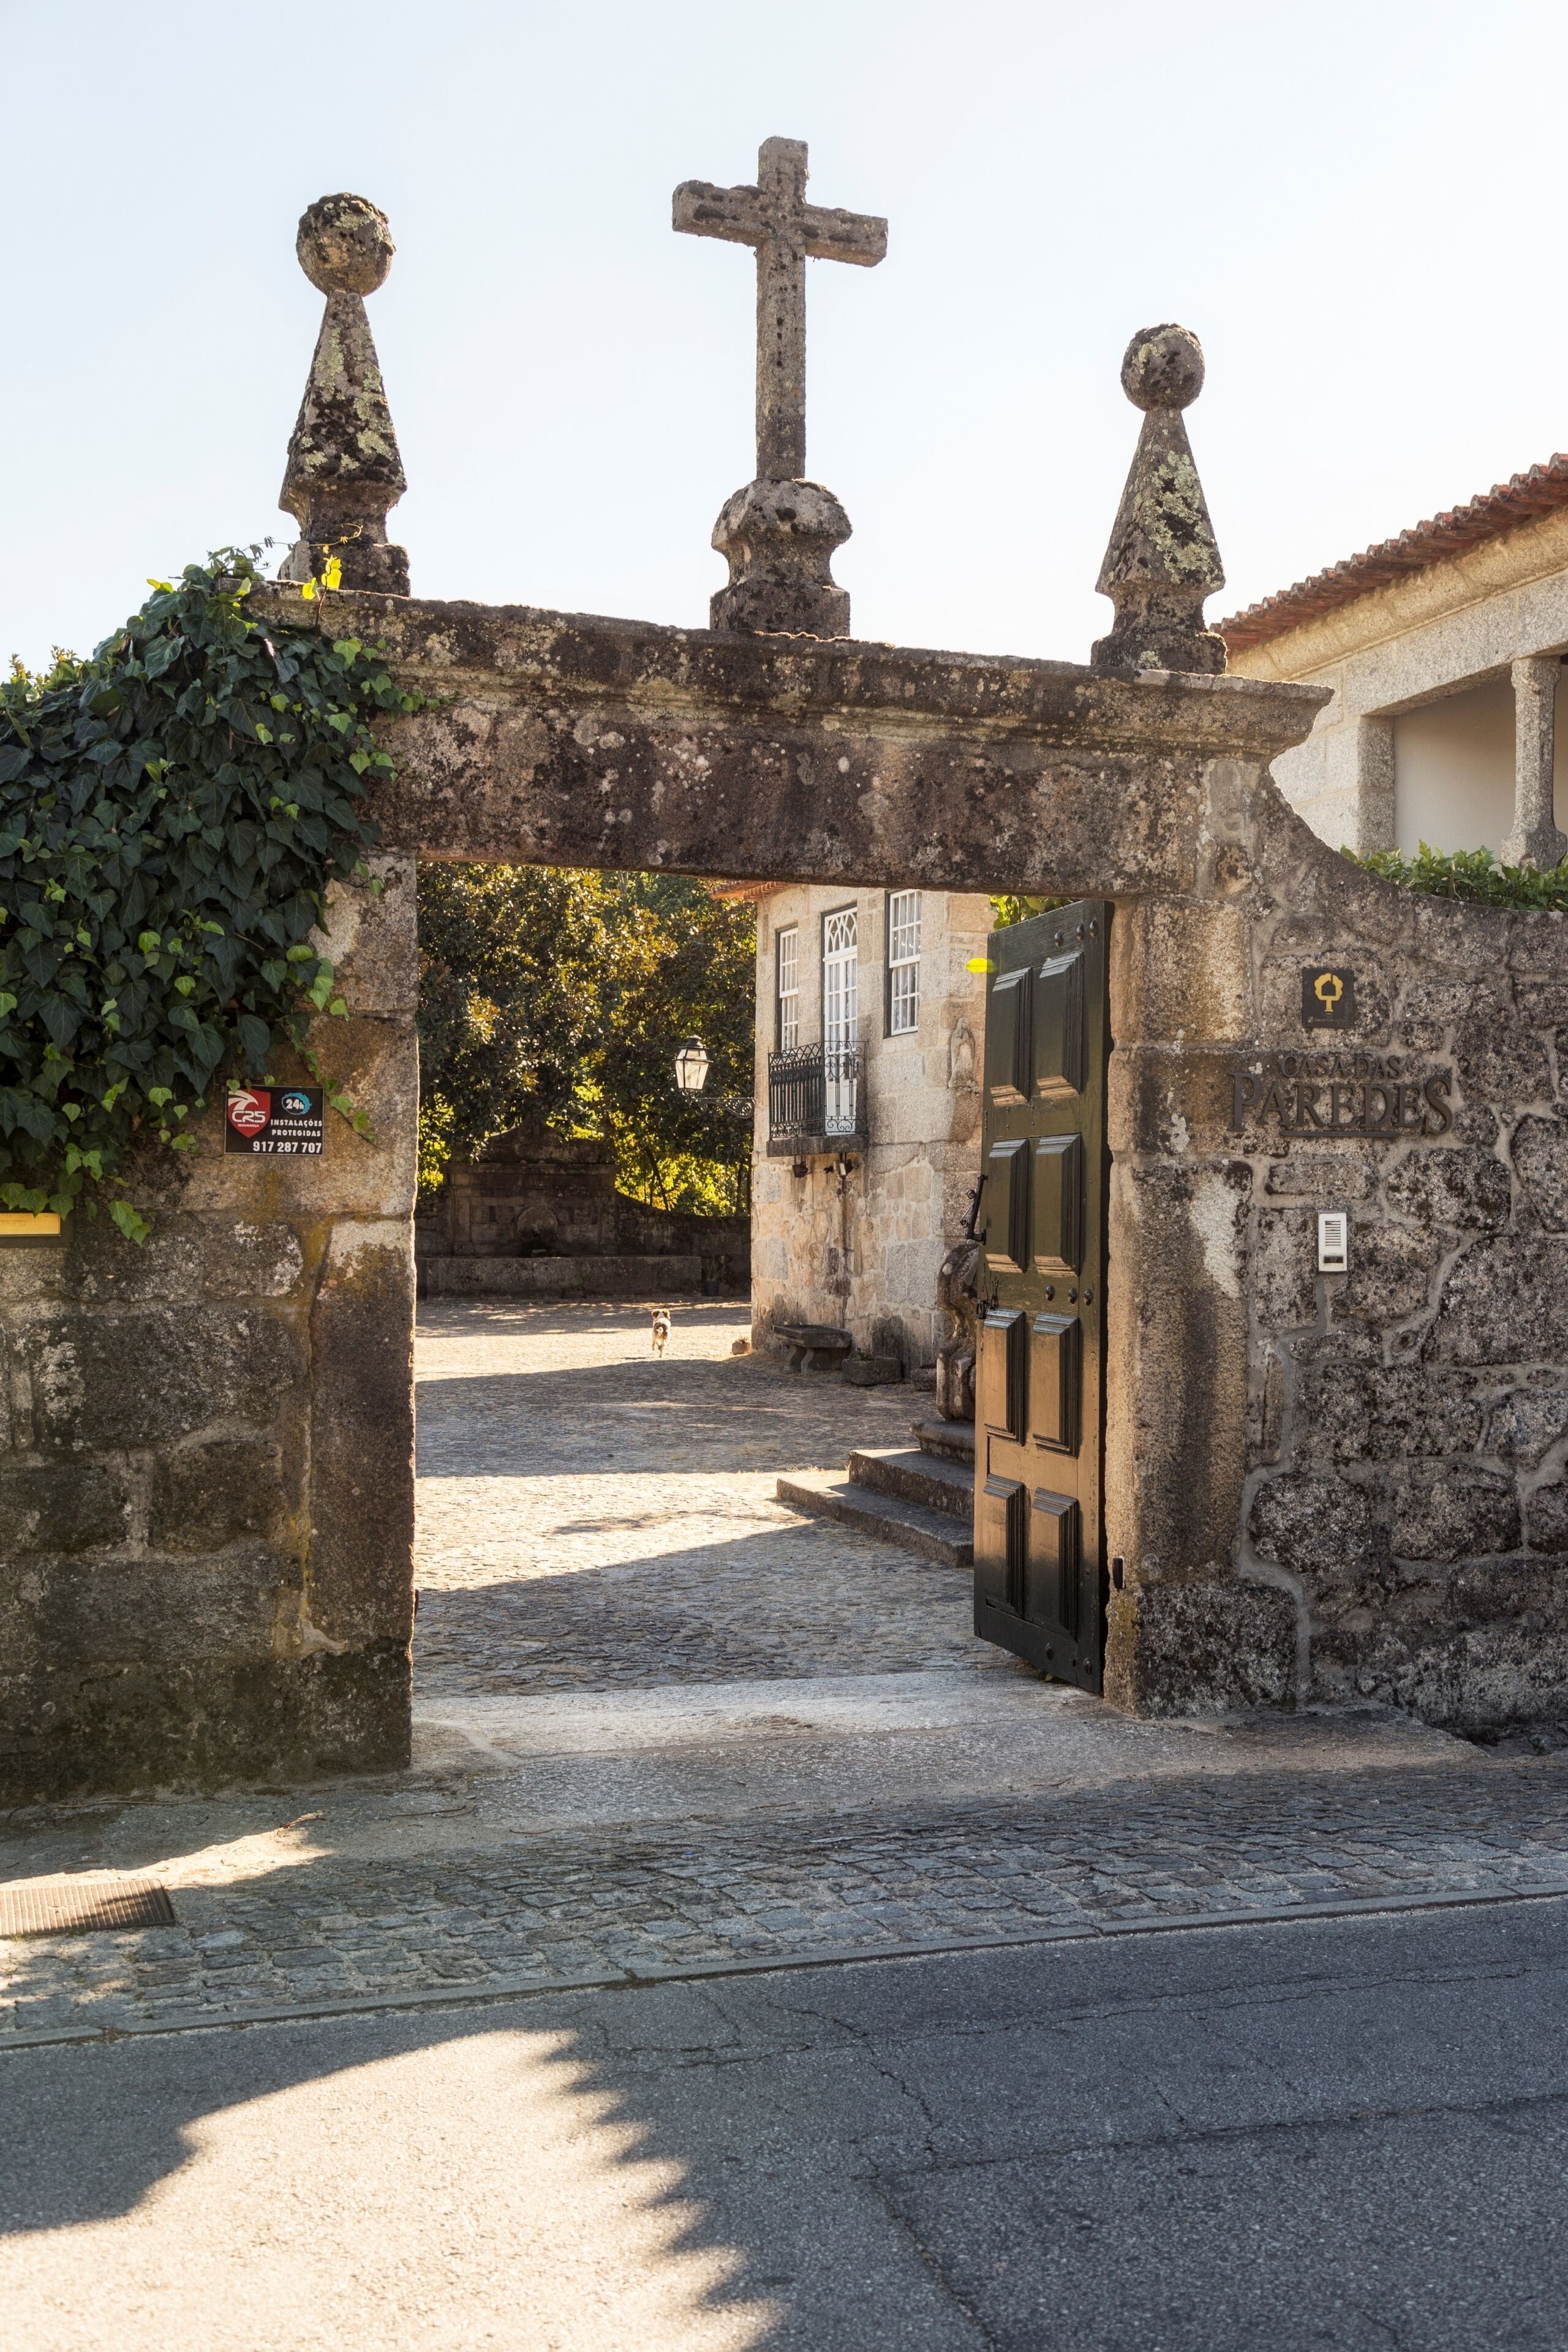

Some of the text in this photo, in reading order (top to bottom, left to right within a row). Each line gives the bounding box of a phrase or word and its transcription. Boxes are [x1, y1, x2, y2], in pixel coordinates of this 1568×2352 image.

[1281, 1055, 1403, 1078] CASA DAS
[286, 1099, 304, 1109] 24h
[1228, 1071, 1453, 1136] PAREDES
[271, 1119, 322, 1128] INSTALAÇÕES
[253, 1140, 322, 1153] 917 287 707
